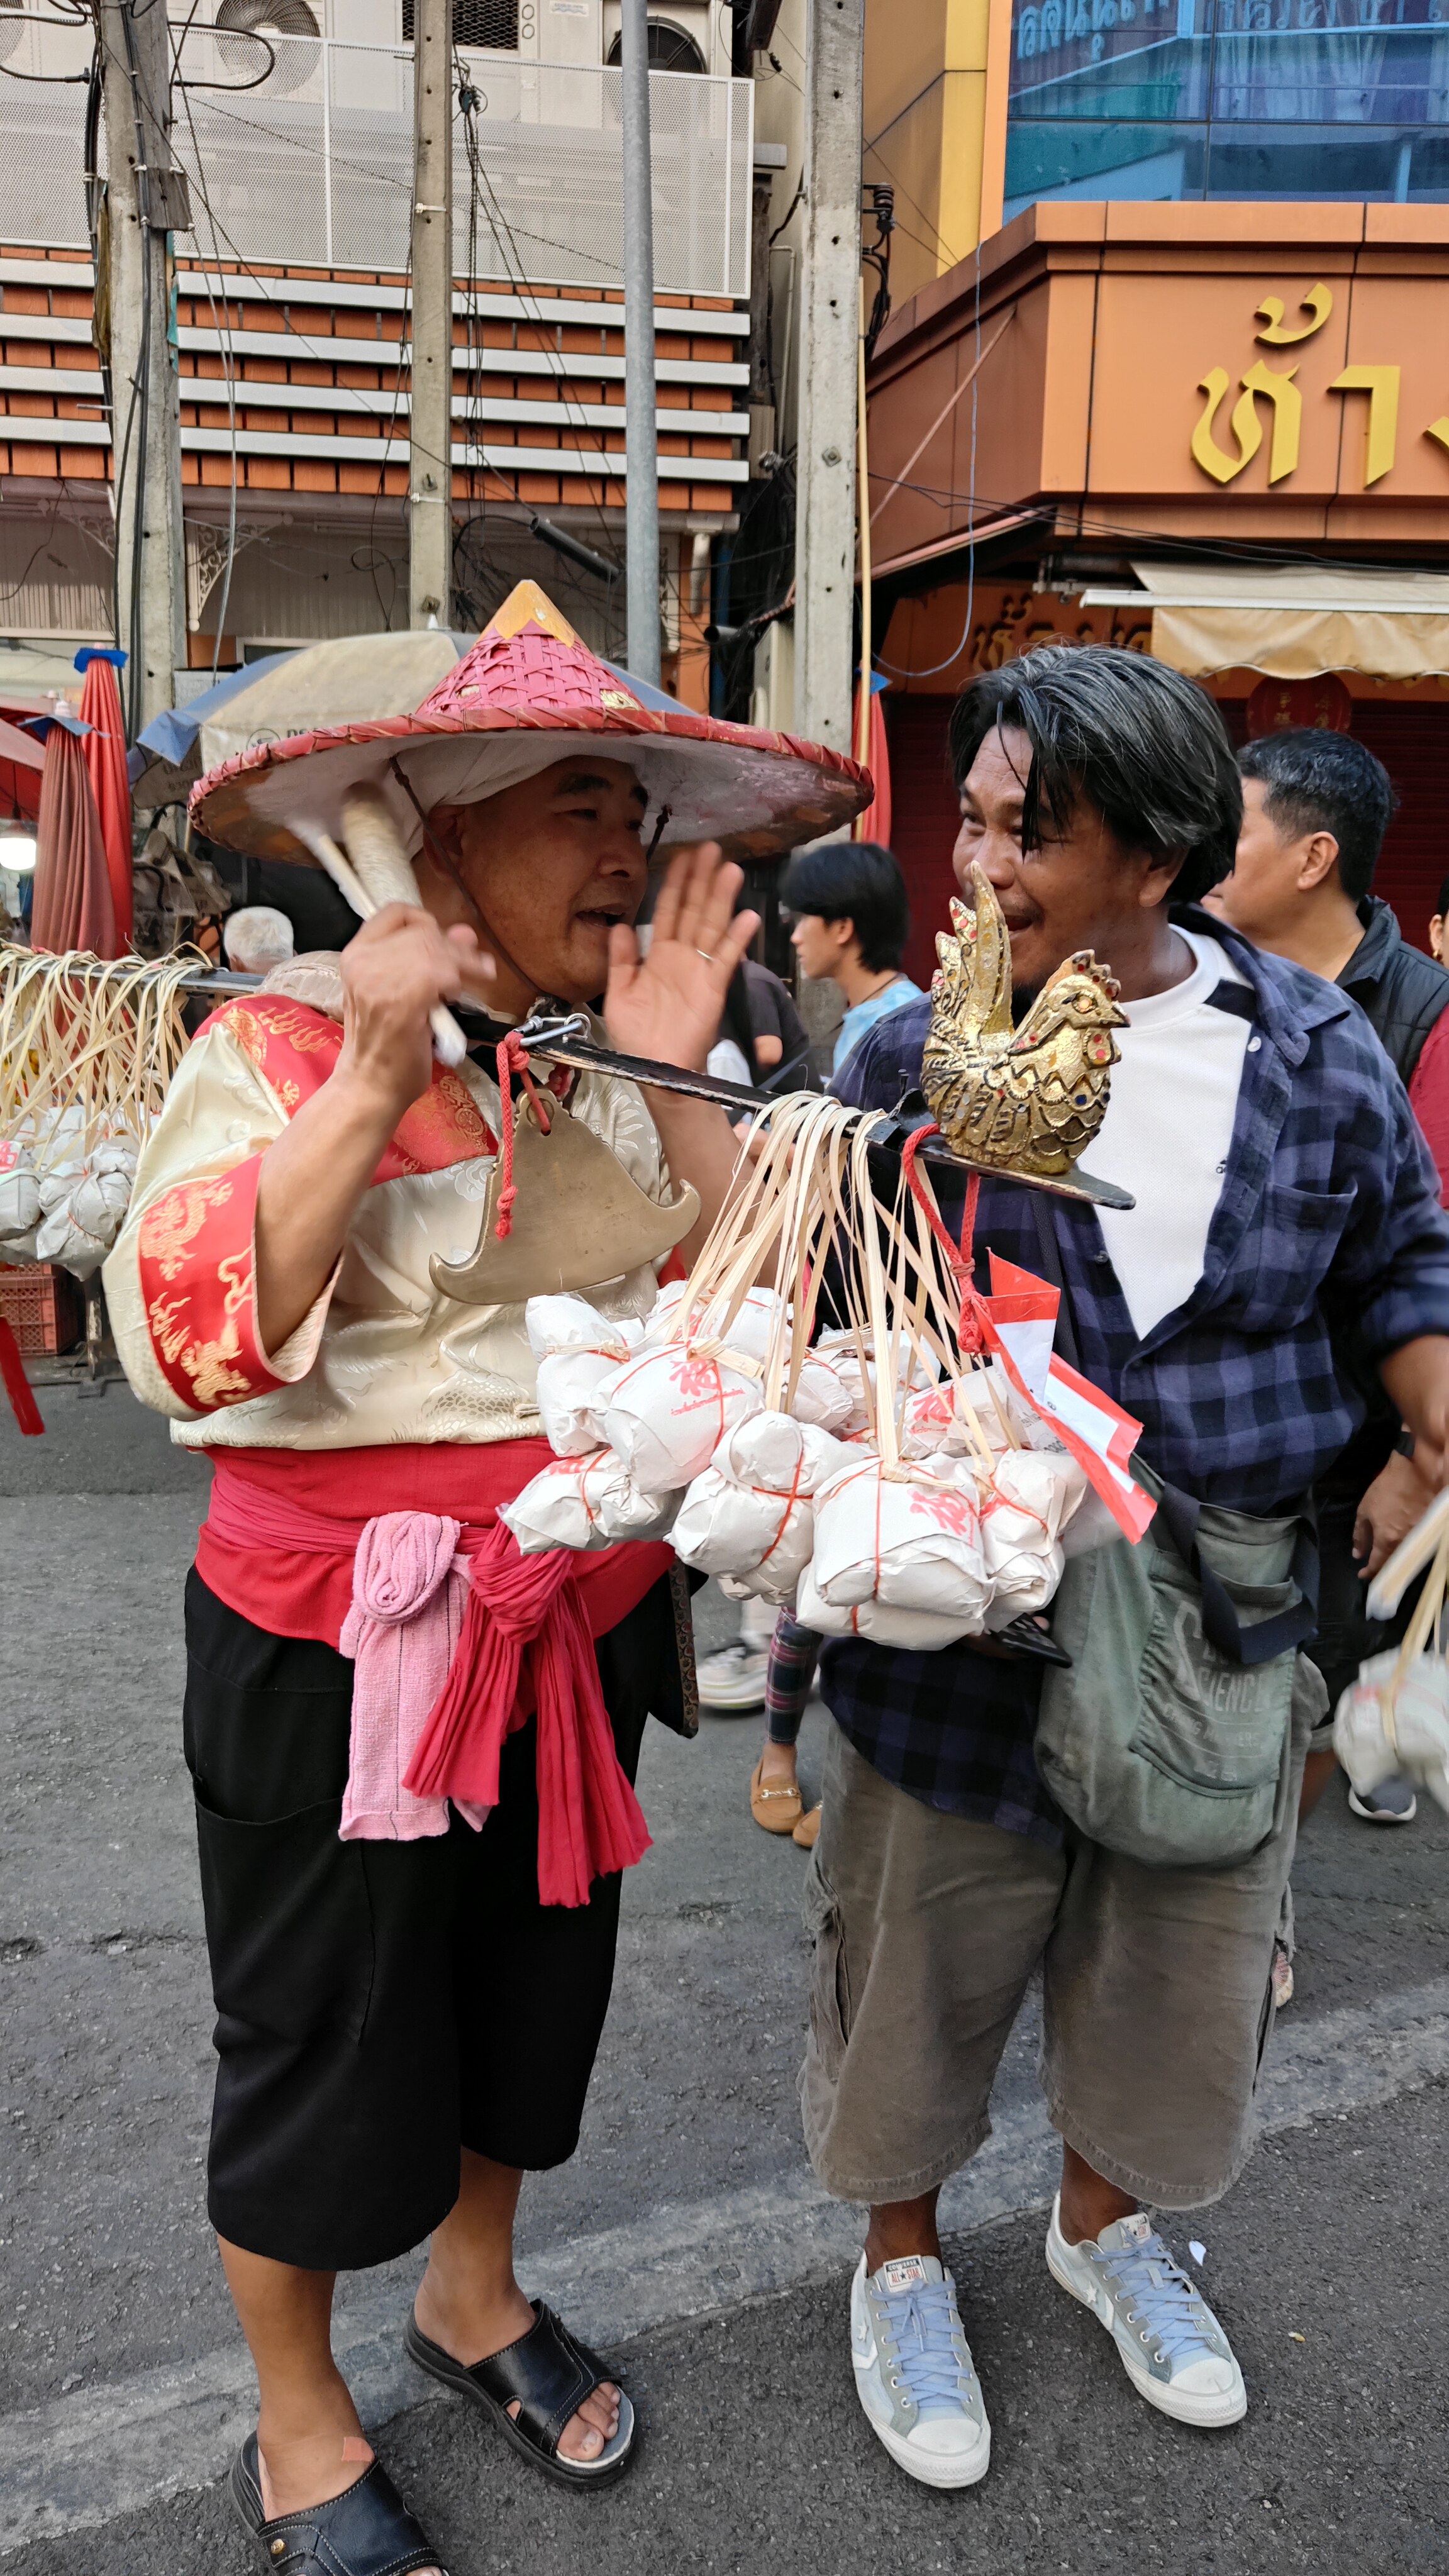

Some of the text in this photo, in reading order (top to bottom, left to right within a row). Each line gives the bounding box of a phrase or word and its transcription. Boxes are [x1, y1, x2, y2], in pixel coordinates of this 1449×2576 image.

[1191, 282, 1449, 490] ห้า
[891, 2267, 920, 2284] ALL STAR
